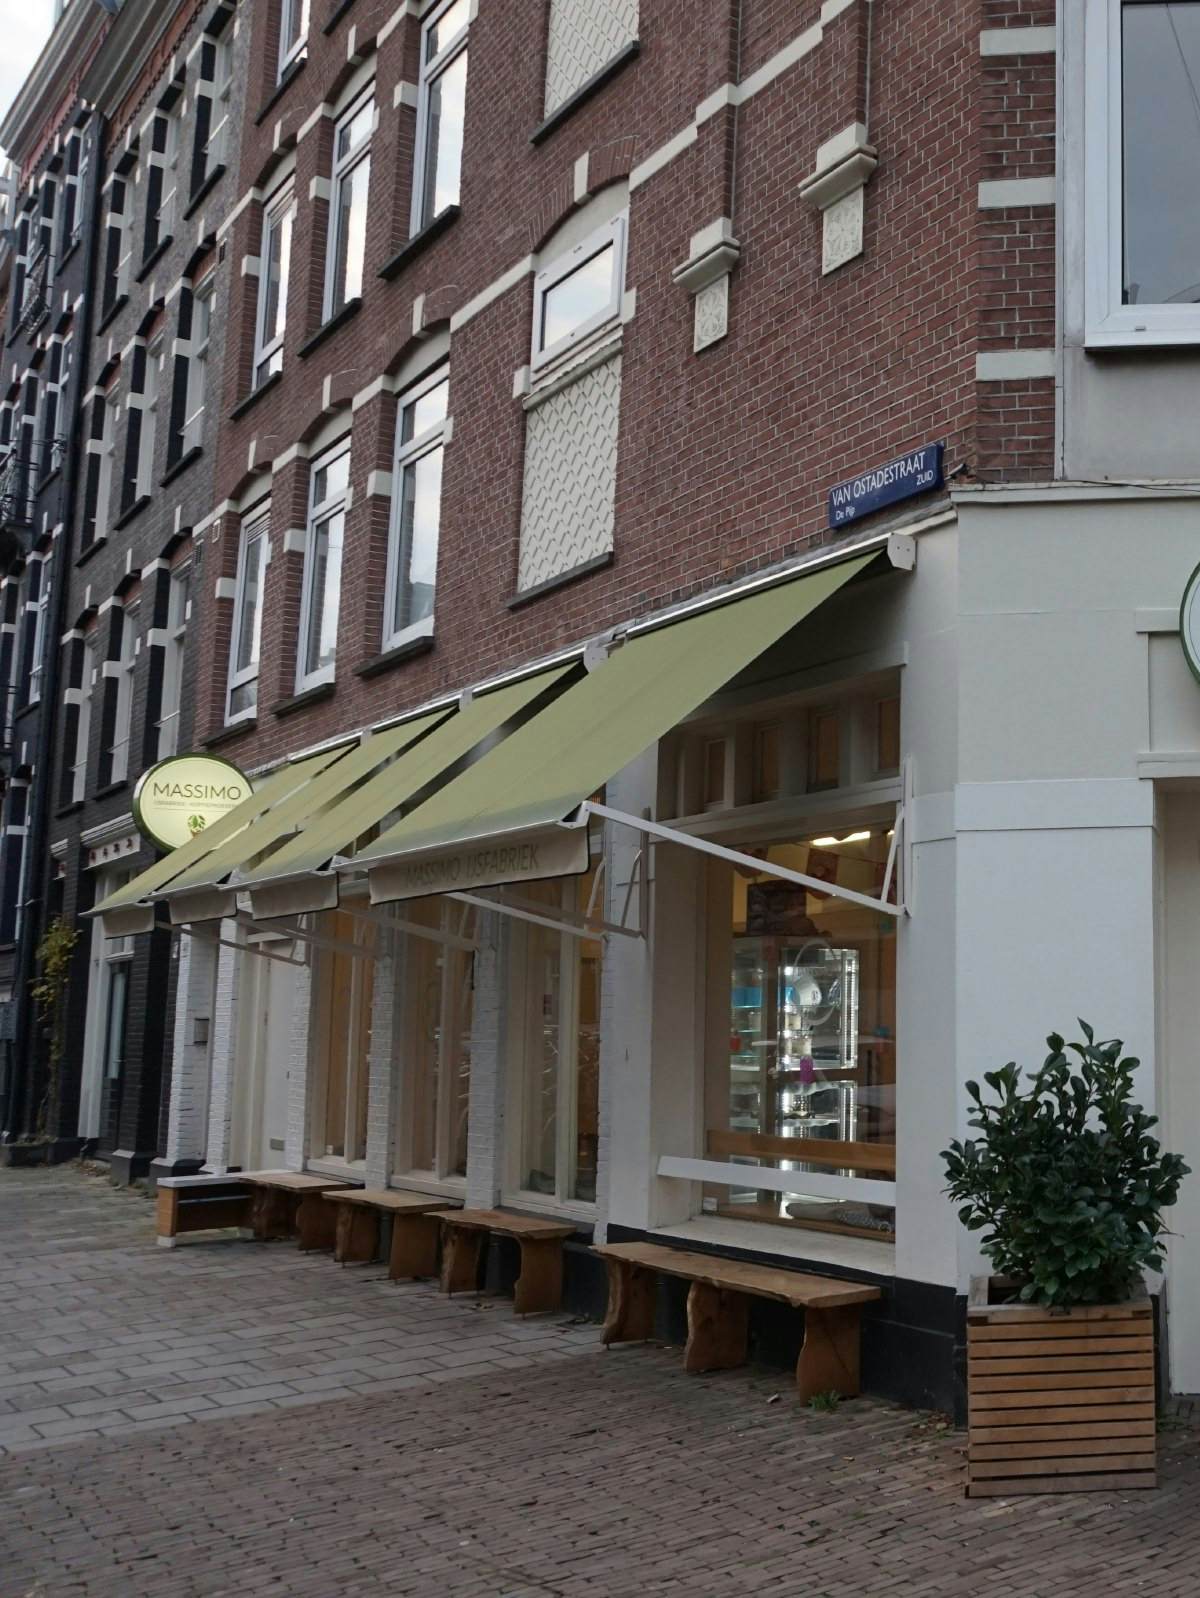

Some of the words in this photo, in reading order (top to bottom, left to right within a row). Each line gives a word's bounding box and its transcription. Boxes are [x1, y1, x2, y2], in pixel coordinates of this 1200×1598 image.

[832, 484, 851, 507] VAN
[853, 451, 926, 498] OSTADESTRAAT
[916, 469, 934, 486] ZUID
[153, 782, 242, 801] MASSIMO
[465, 843, 540, 880] IJSFABRIEK
